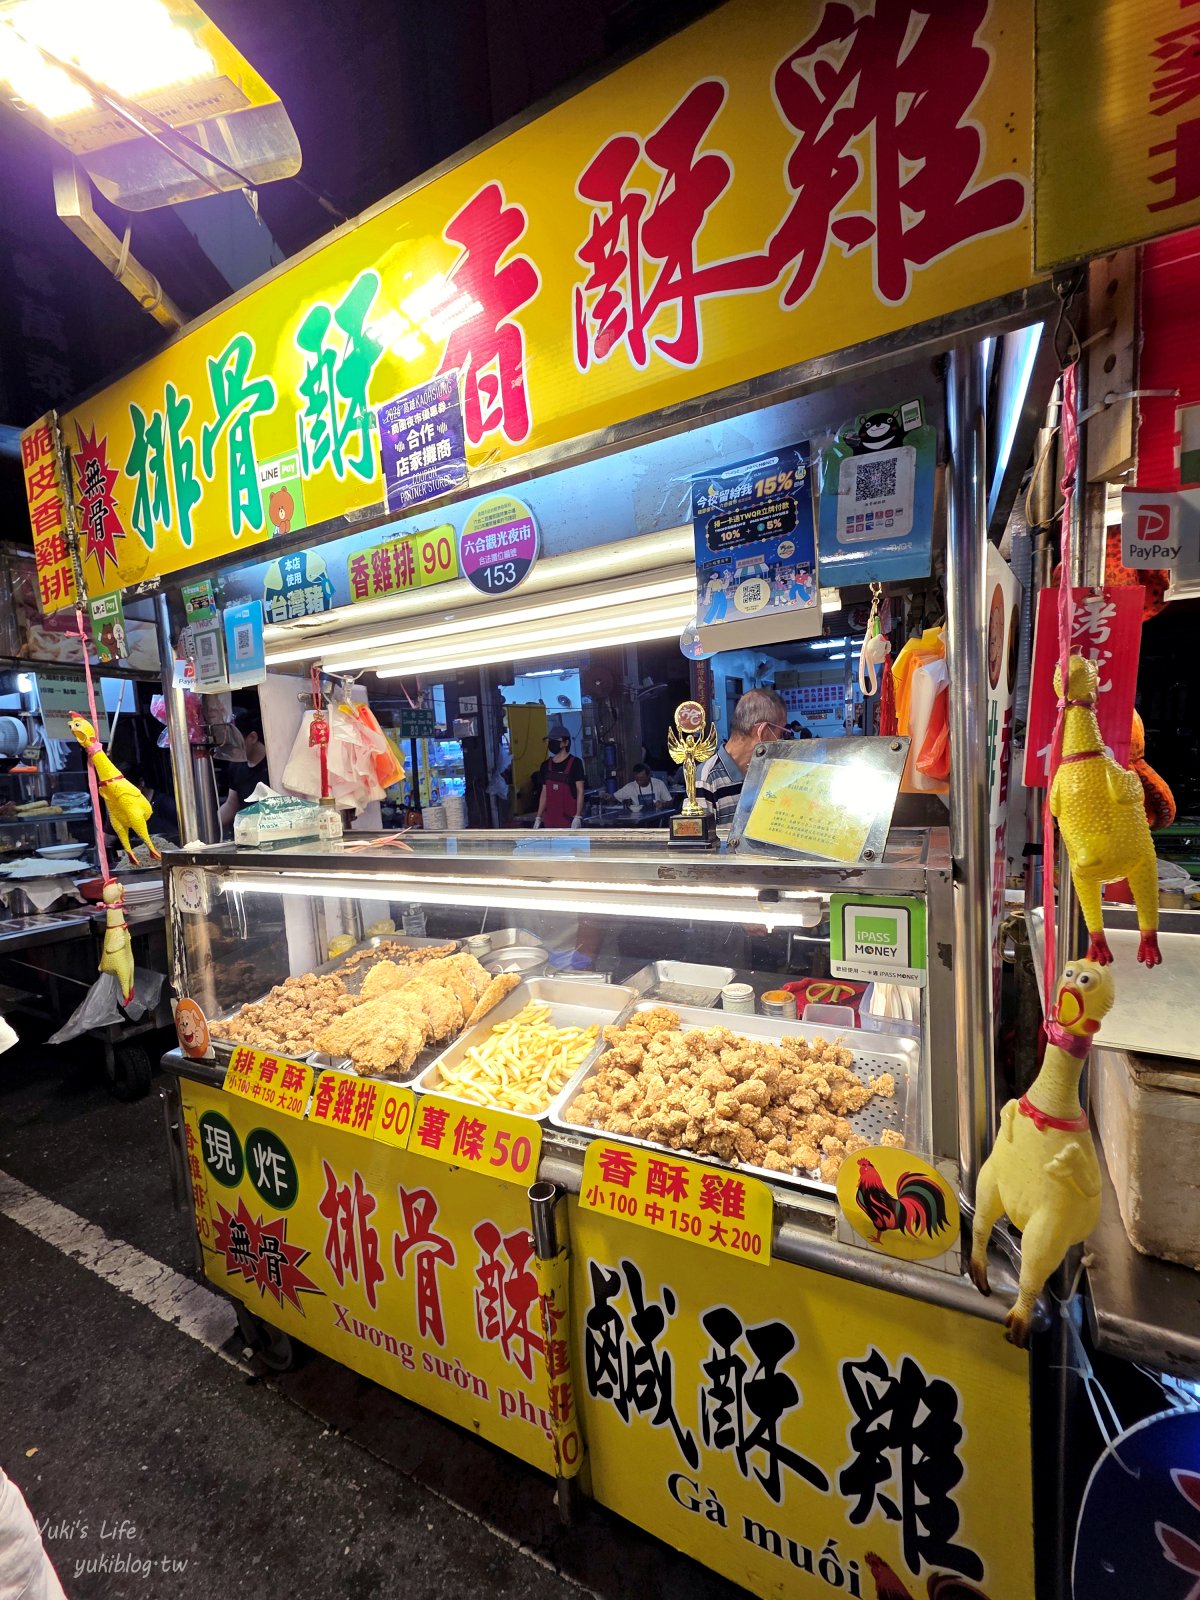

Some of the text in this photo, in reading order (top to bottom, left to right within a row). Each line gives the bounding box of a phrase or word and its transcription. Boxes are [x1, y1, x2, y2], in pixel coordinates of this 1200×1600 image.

[125, 273, 383, 549] 排骨酥
[396, 438, 451, 477] 店家攤商
[406, 423, 435, 450] 合作
[260, 463, 296, 482] LINE Pay
[400, 483, 427, 503] PARTNER
[755, 471, 793, 498] 15%
[21, 424, 77, 605] 脆皮香雞排
[84, 460, 109, 542] 無骨
[464, 525, 531, 556] 六合觀光夜市
[720, 529, 741, 542] 10%
[766, 518, 782, 529] 5%
[285, 557, 300, 571] 本店
[350, 537, 450, 598] 香雞排 90
[1129, 544, 1182, 560] PayPay
[286, 572, 302, 586] 使用
[484, 562, 516, 587] 153
[271, 585, 324, 622] 台灣豬
[854, 944, 897, 957] MONEY
[857, 931, 890, 943] iPASS
[233, 1048, 307, 1093] 排骨酥
[314, 1076, 410, 1135] 香雞排 90
[204, 1123, 289, 1197] 現炸
[417, 1106, 532, 1173] 薯條 50
[598, 1148, 746, 1220] 香酥雞
[229, 1219, 289, 1287] 無骨
[318, 1160, 545, 1381] 排骨酥
[333, 1302, 415, 1369] Xương
[423, 1349, 490, 1400] sườn
[586, 1259, 984, 1581] 鹹酥雞
[667, 1473, 865, 1600] Gà muối
